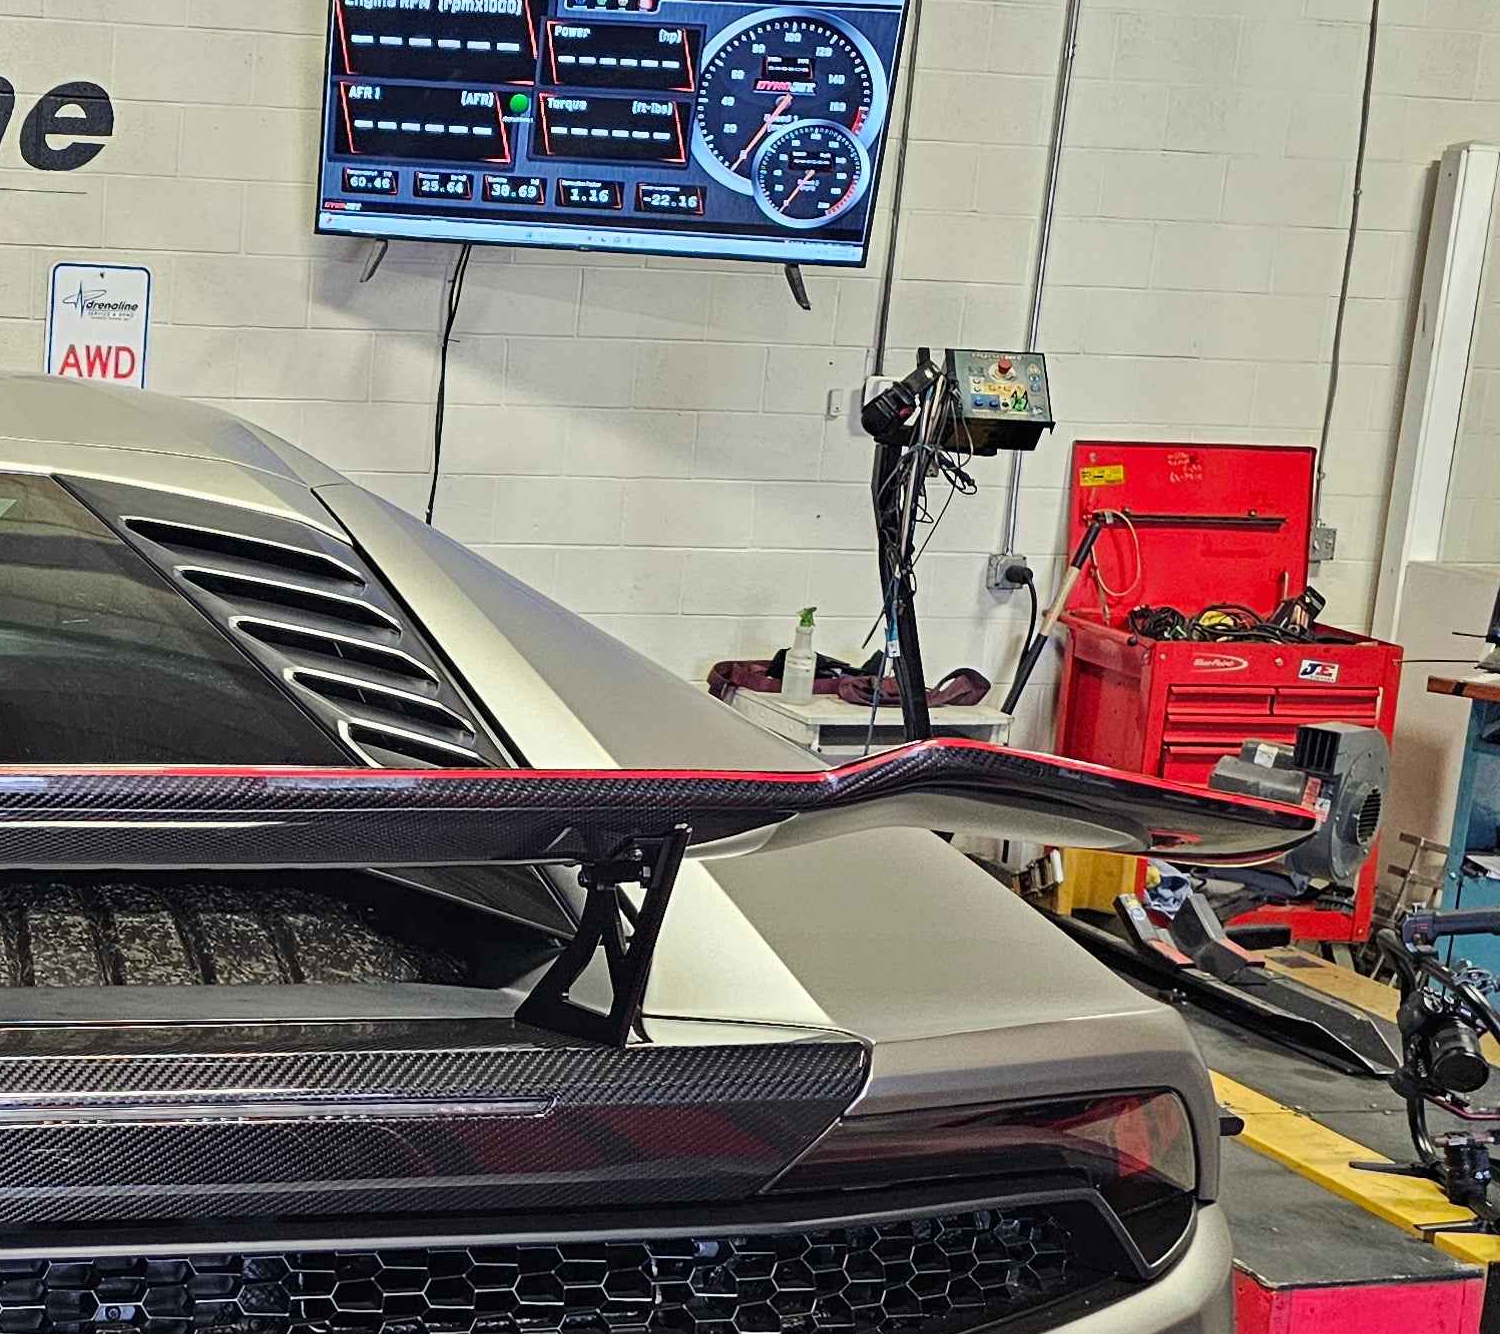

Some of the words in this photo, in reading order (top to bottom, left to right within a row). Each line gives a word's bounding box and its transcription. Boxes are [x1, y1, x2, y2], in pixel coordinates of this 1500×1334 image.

[555, 25, 591, 38] Power
[349, 85, 371, 100] AFR
[461, 90, 494, 107] (AFR)
[547, 98, 588, 112] Torque
[569, 188, 609, 203] 1.16
[643, 193, 698, 208] -22.16
[59, 344, 135, 379] AWD
